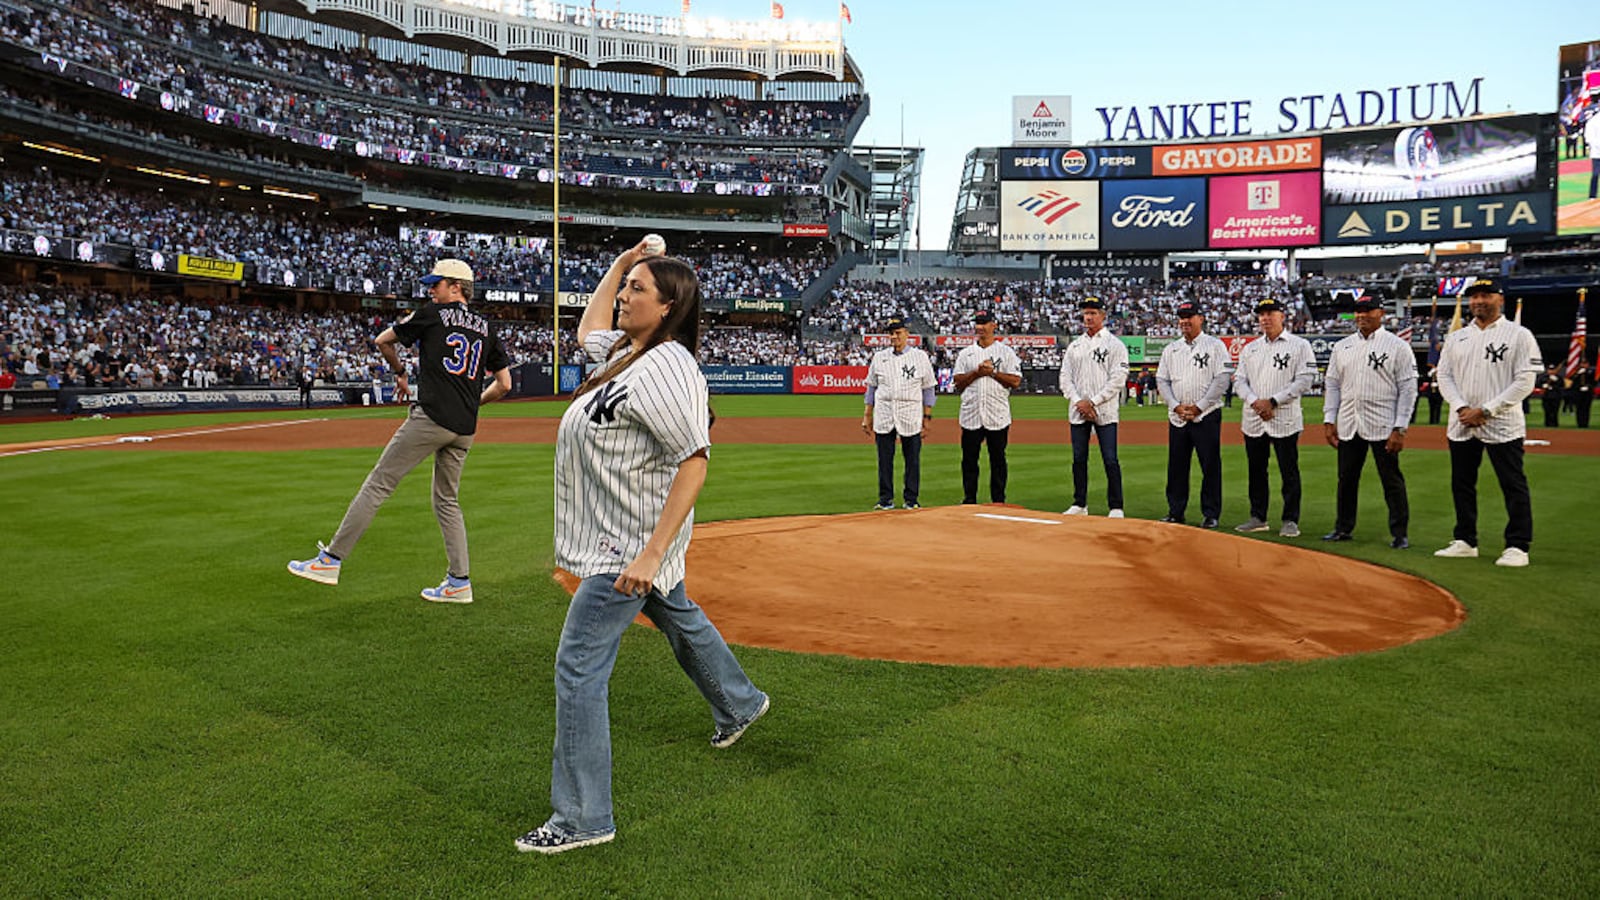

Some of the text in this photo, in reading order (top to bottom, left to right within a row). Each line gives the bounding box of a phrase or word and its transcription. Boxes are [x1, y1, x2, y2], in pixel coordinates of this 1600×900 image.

[1095, 77, 1485, 142] YANKEE STADIUM
[1019, 118, 1066, 129] Benjamin
[1026, 129, 1058, 138] Moore
[1014, 157, 1050, 168] PEPSI
[1099, 156, 1136, 168] PEPSI
[1161, 142, 1312, 170] GATORADE
[1254, 185, 1273, 205] T
[1111, 194, 1197, 228] Ford
[1384, 200, 1538, 233] DELTA
[1224, 214, 1304, 229] America's
[1002, 232, 1096, 242] BANK OF AMERICA
[1211, 224, 1317, 240] Best Network
[567, 293, 592, 305] OR
[443, 332, 483, 380] 31
[1092, 347, 1109, 363] NY
[1367, 351, 1389, 370] NY
[1485, 342, 1509, 363] NY
[1193, 353, 1210, 369] NY
[1273, 353, 1291, 370] NY
[902, 364, 917, 380] NY
[584, 380, 629, 425] NY
